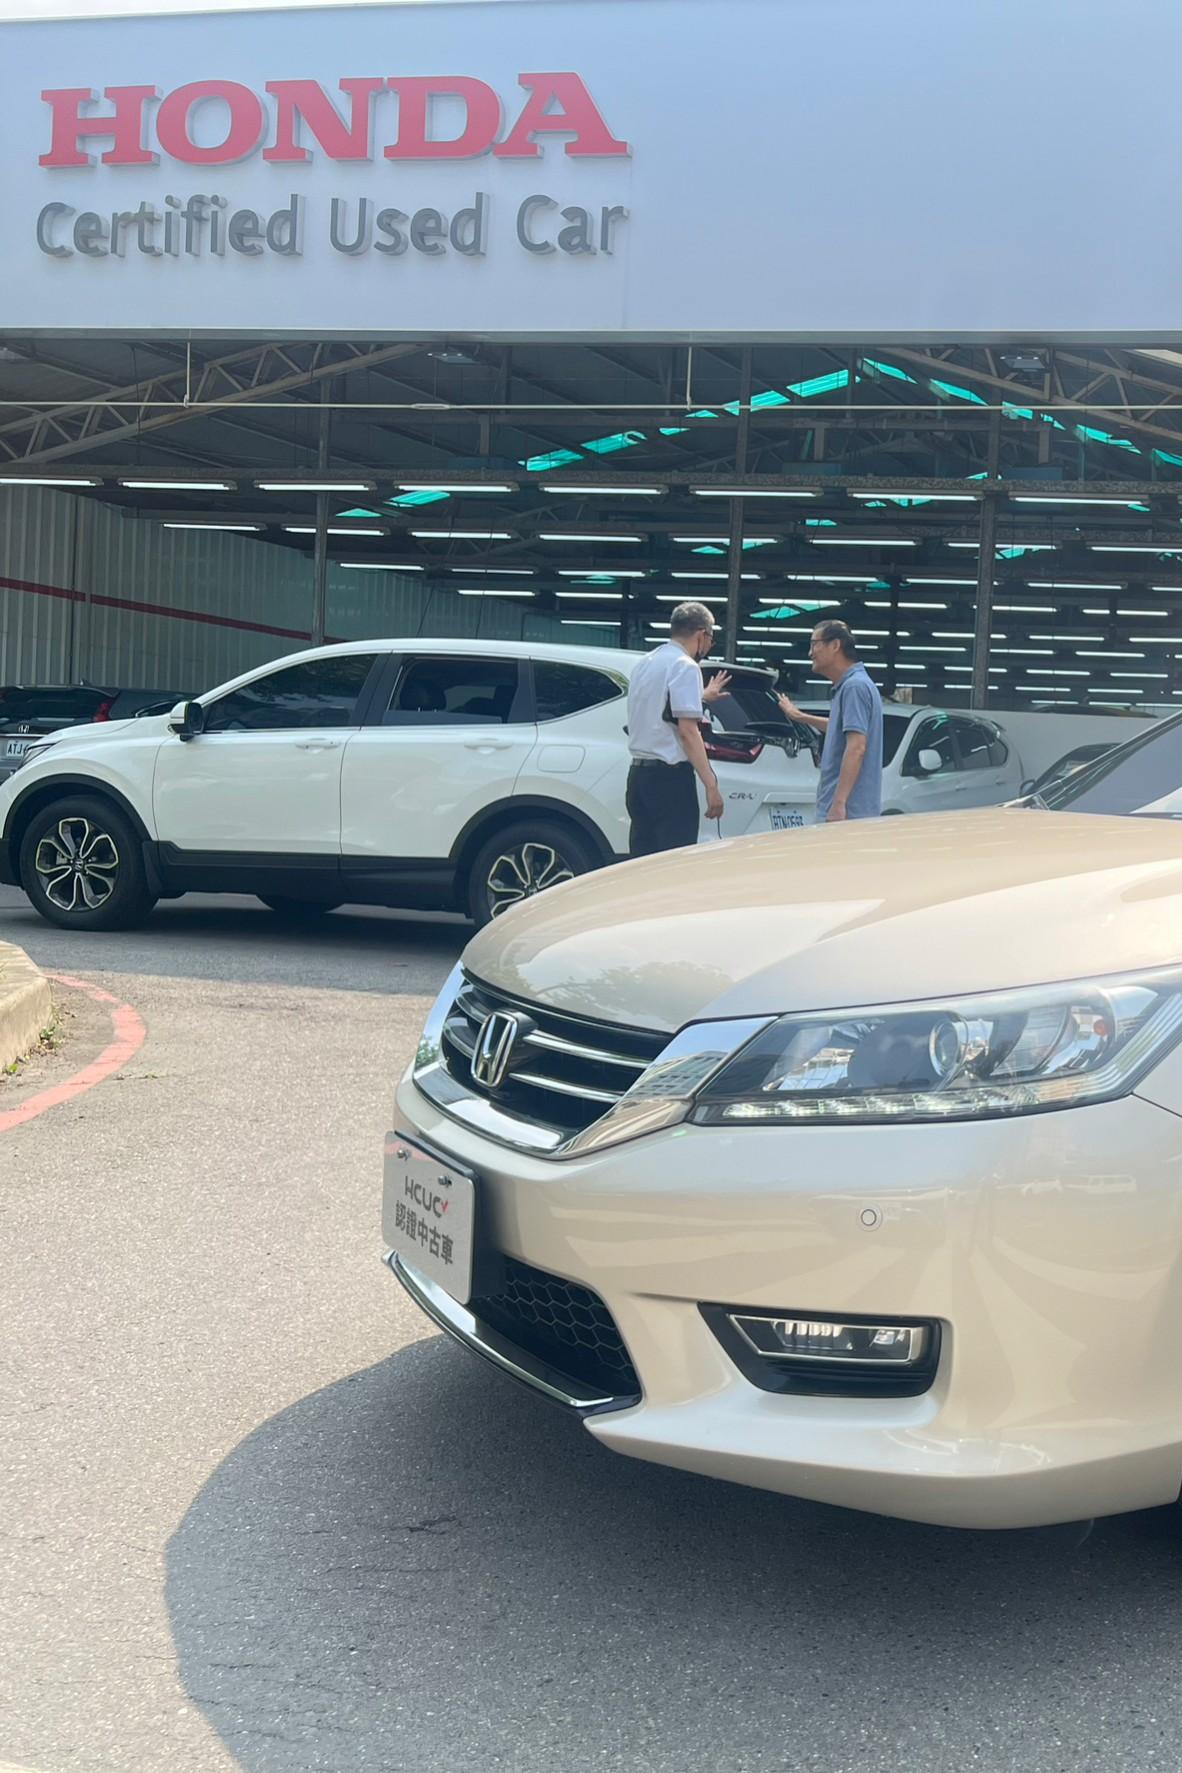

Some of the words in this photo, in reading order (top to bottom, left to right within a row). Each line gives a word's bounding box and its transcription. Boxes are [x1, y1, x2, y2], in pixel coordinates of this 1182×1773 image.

[38, 71, 631, 167] HONDA
[36, 193, 302, 258] Certified
[329, 191, 489, 257] Used
[516, 193, 630, 255] Car
[404, 1175, 443, 1218] HCUC
[395, 1200, 454, 1265] 認證中古車
